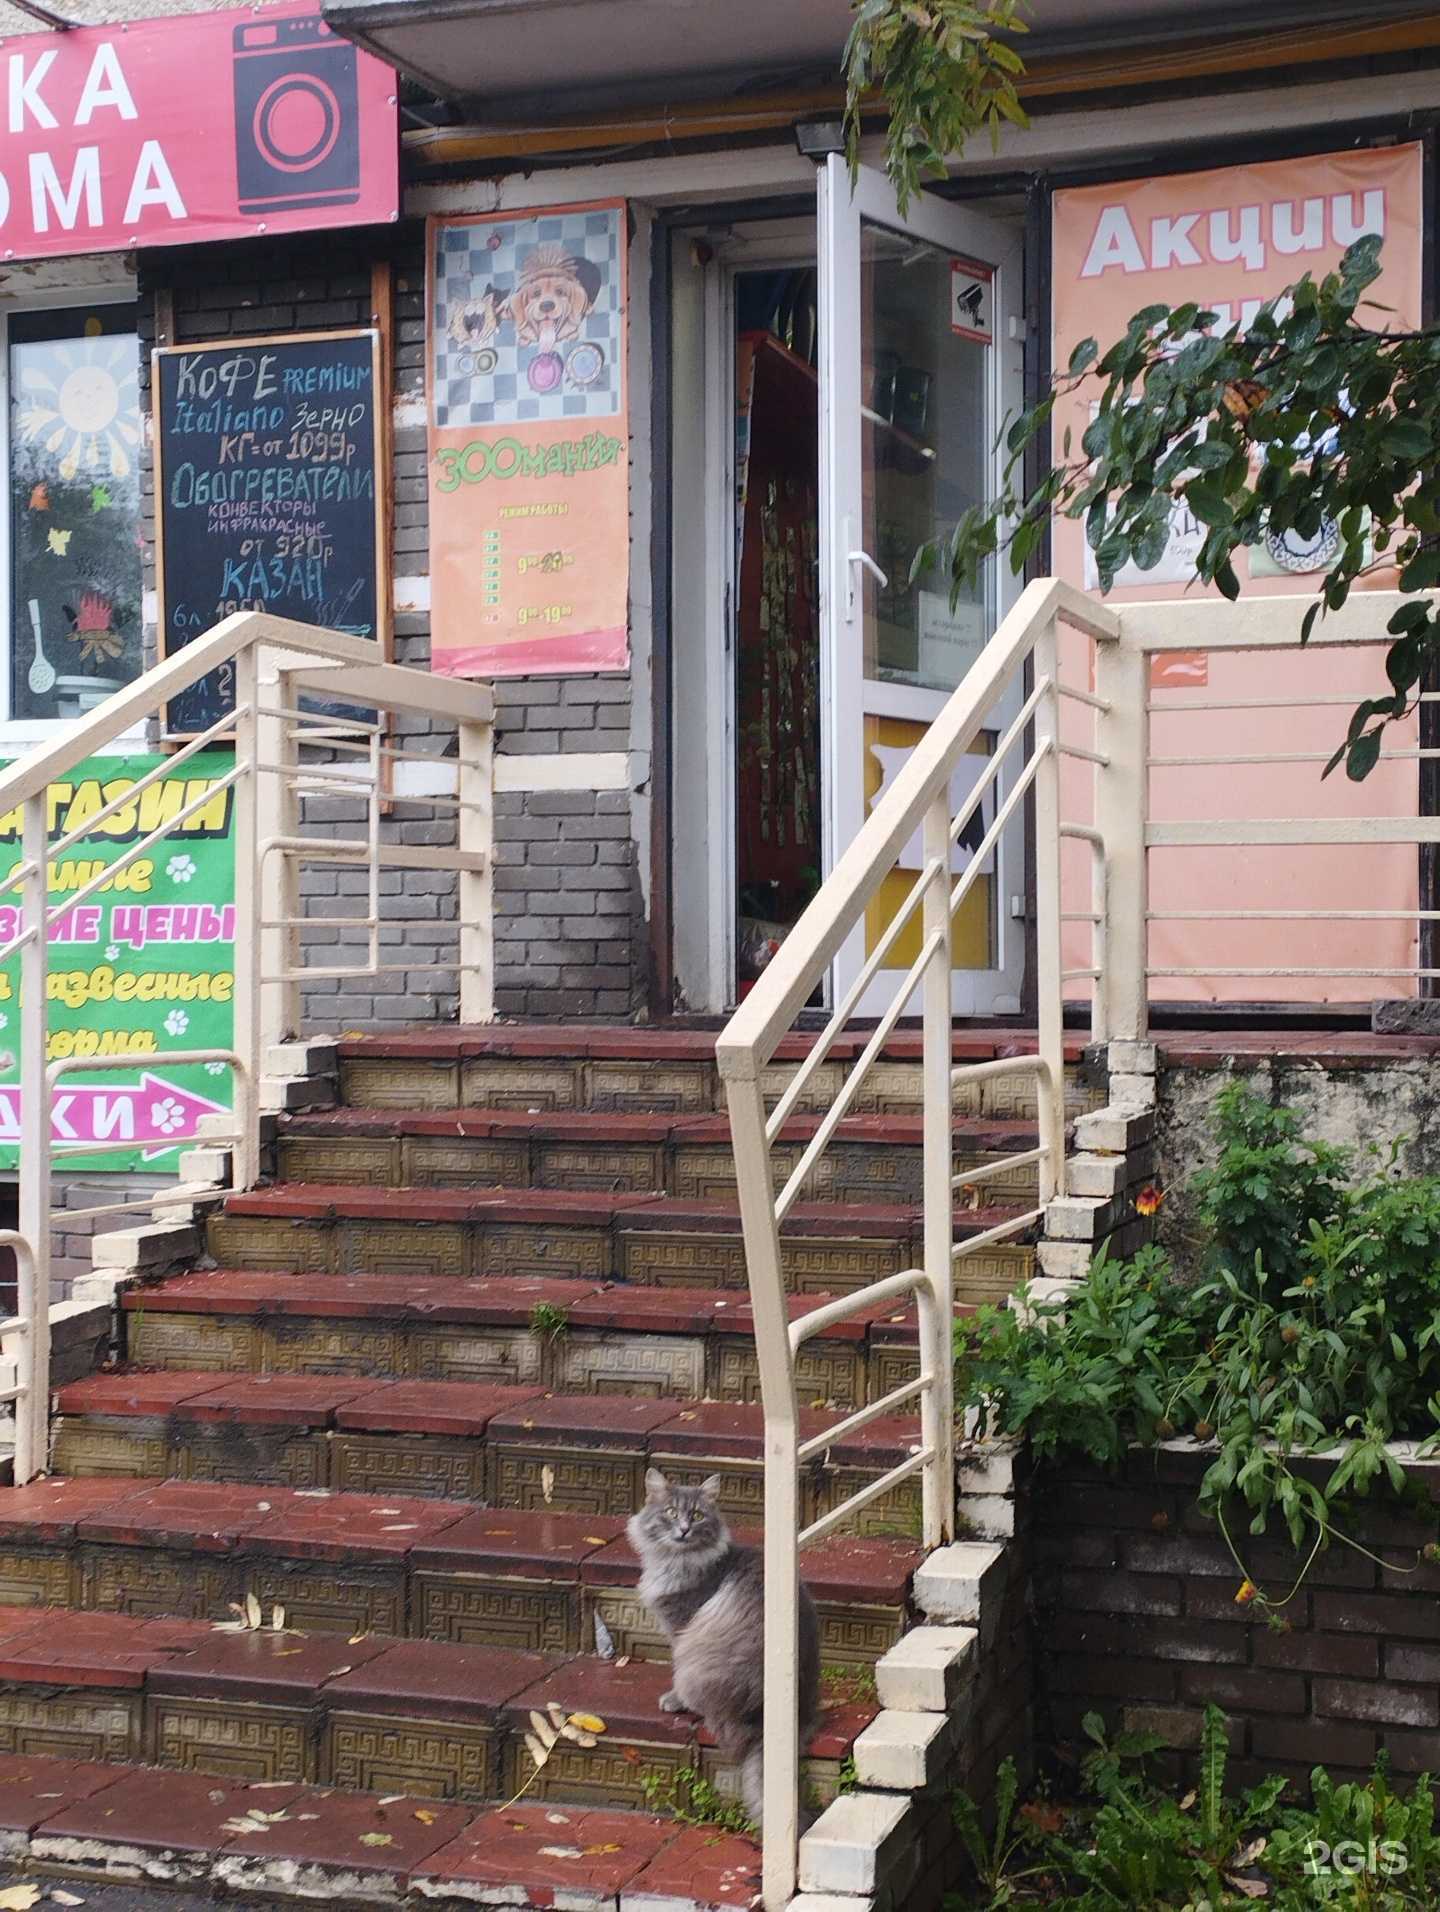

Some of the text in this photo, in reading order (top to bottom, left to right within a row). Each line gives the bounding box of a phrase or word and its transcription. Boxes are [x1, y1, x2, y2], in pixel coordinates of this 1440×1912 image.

[0, 139, 188, 233] МА
[1079, 188, 1386, 275] Акции
[170, 400, 285, 434] Italiano
[19, 965, 234, 1008] азвесные
[46, 1028, 158, 1060] орма
